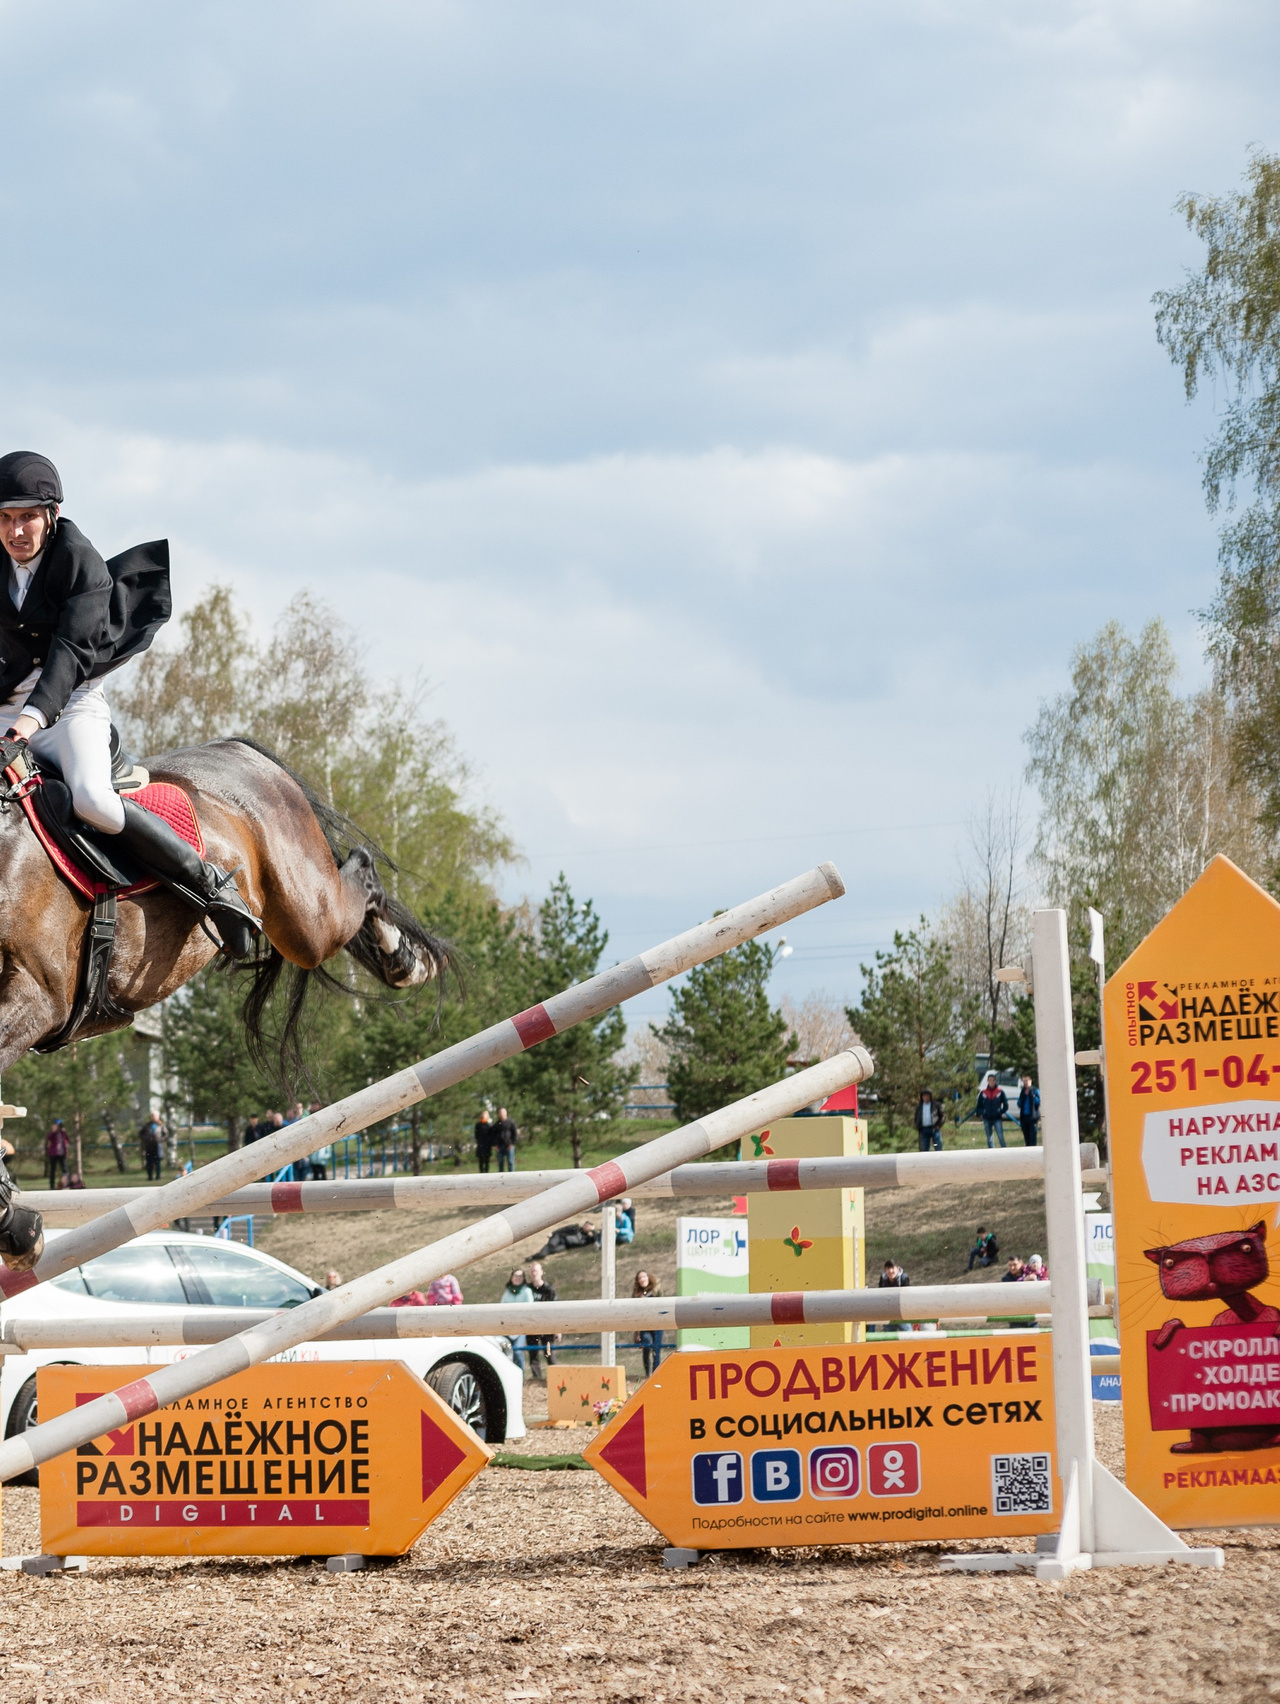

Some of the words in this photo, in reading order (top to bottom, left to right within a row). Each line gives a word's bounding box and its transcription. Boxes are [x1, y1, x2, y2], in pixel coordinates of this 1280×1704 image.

[1180, 979, 1255, 991] РЕКЛАМНОЕ
[1264, 977, 1280, 985] АГ
[1140, 1016, 1279, 1046] РАЗМЕЩЕ
[1131, 1054, 1280, 1094] 251-04-
[1180, 1143, 1279, 1166] РЕКЛАМ
[1197, 1176, 1230, 1195] НА
[1235, 1173, 1280, 1193] АЗС
[687, 1229, 720, 1244] ЛОР
[689, 1345, 1038, 1402] ПРОДВИЖЕНИЕ
[1204, 1363, 1280, 1386] ХОЛДЕ
[263, 1396, 369, 1410] АГЕНТСТВО
[715, 1405, 934, 1441] социальных
[942, 1400, 1043, 1427] сетях
[138, 1411, 369, 1456] НАДЁЖНОЕ
[77, 1459, 369, 1496] РАЗМЕЩЕНИЕ
[1163, 1468, 1280, 1489] РЕКЛАМАА
[121, 1504, 325, 1522] DIGITAL
[692, 1513, 783, 1530] Подробности
[786, 1514, 803, 1525] на
[805, 1511, 845, 1524] сайте
[847, 1504, 988, 1523] www.prodigital.online
